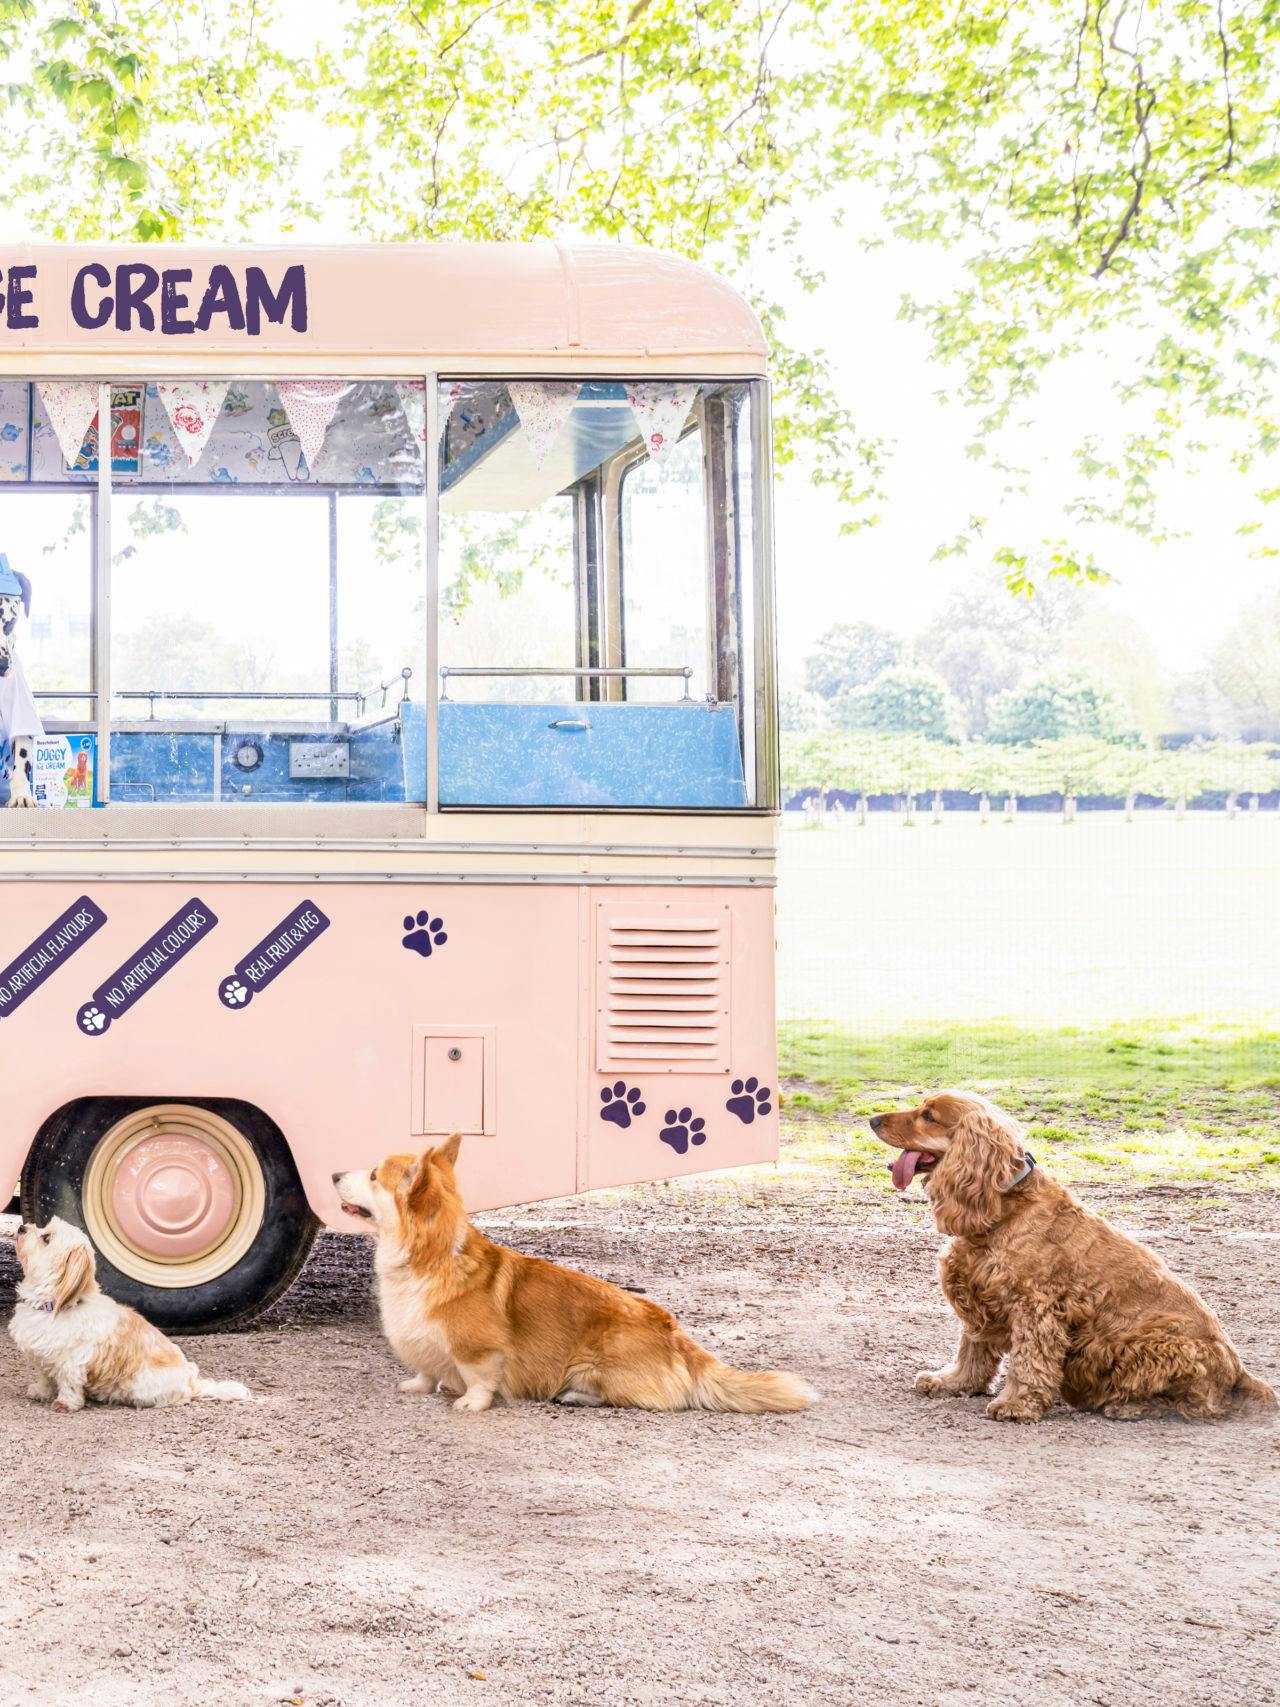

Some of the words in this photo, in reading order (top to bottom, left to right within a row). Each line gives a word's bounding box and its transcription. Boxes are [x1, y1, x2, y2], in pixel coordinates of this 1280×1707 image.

[71, 263, 307, 335] CREAM
[111, 391, 140, 408] AT
[36, 748, 67, 762] DOGGY
[7, 948, 54, 995] ARTIFICIAL
[46, 908, 94, 957] FLAVOURS
[104, 987, 125, 1009] NO
[122, 947, 169, 995] ARTIFICIAL
[161, 909, 207, 954] COLOURS
[244, 955, 274, 983] REAL
